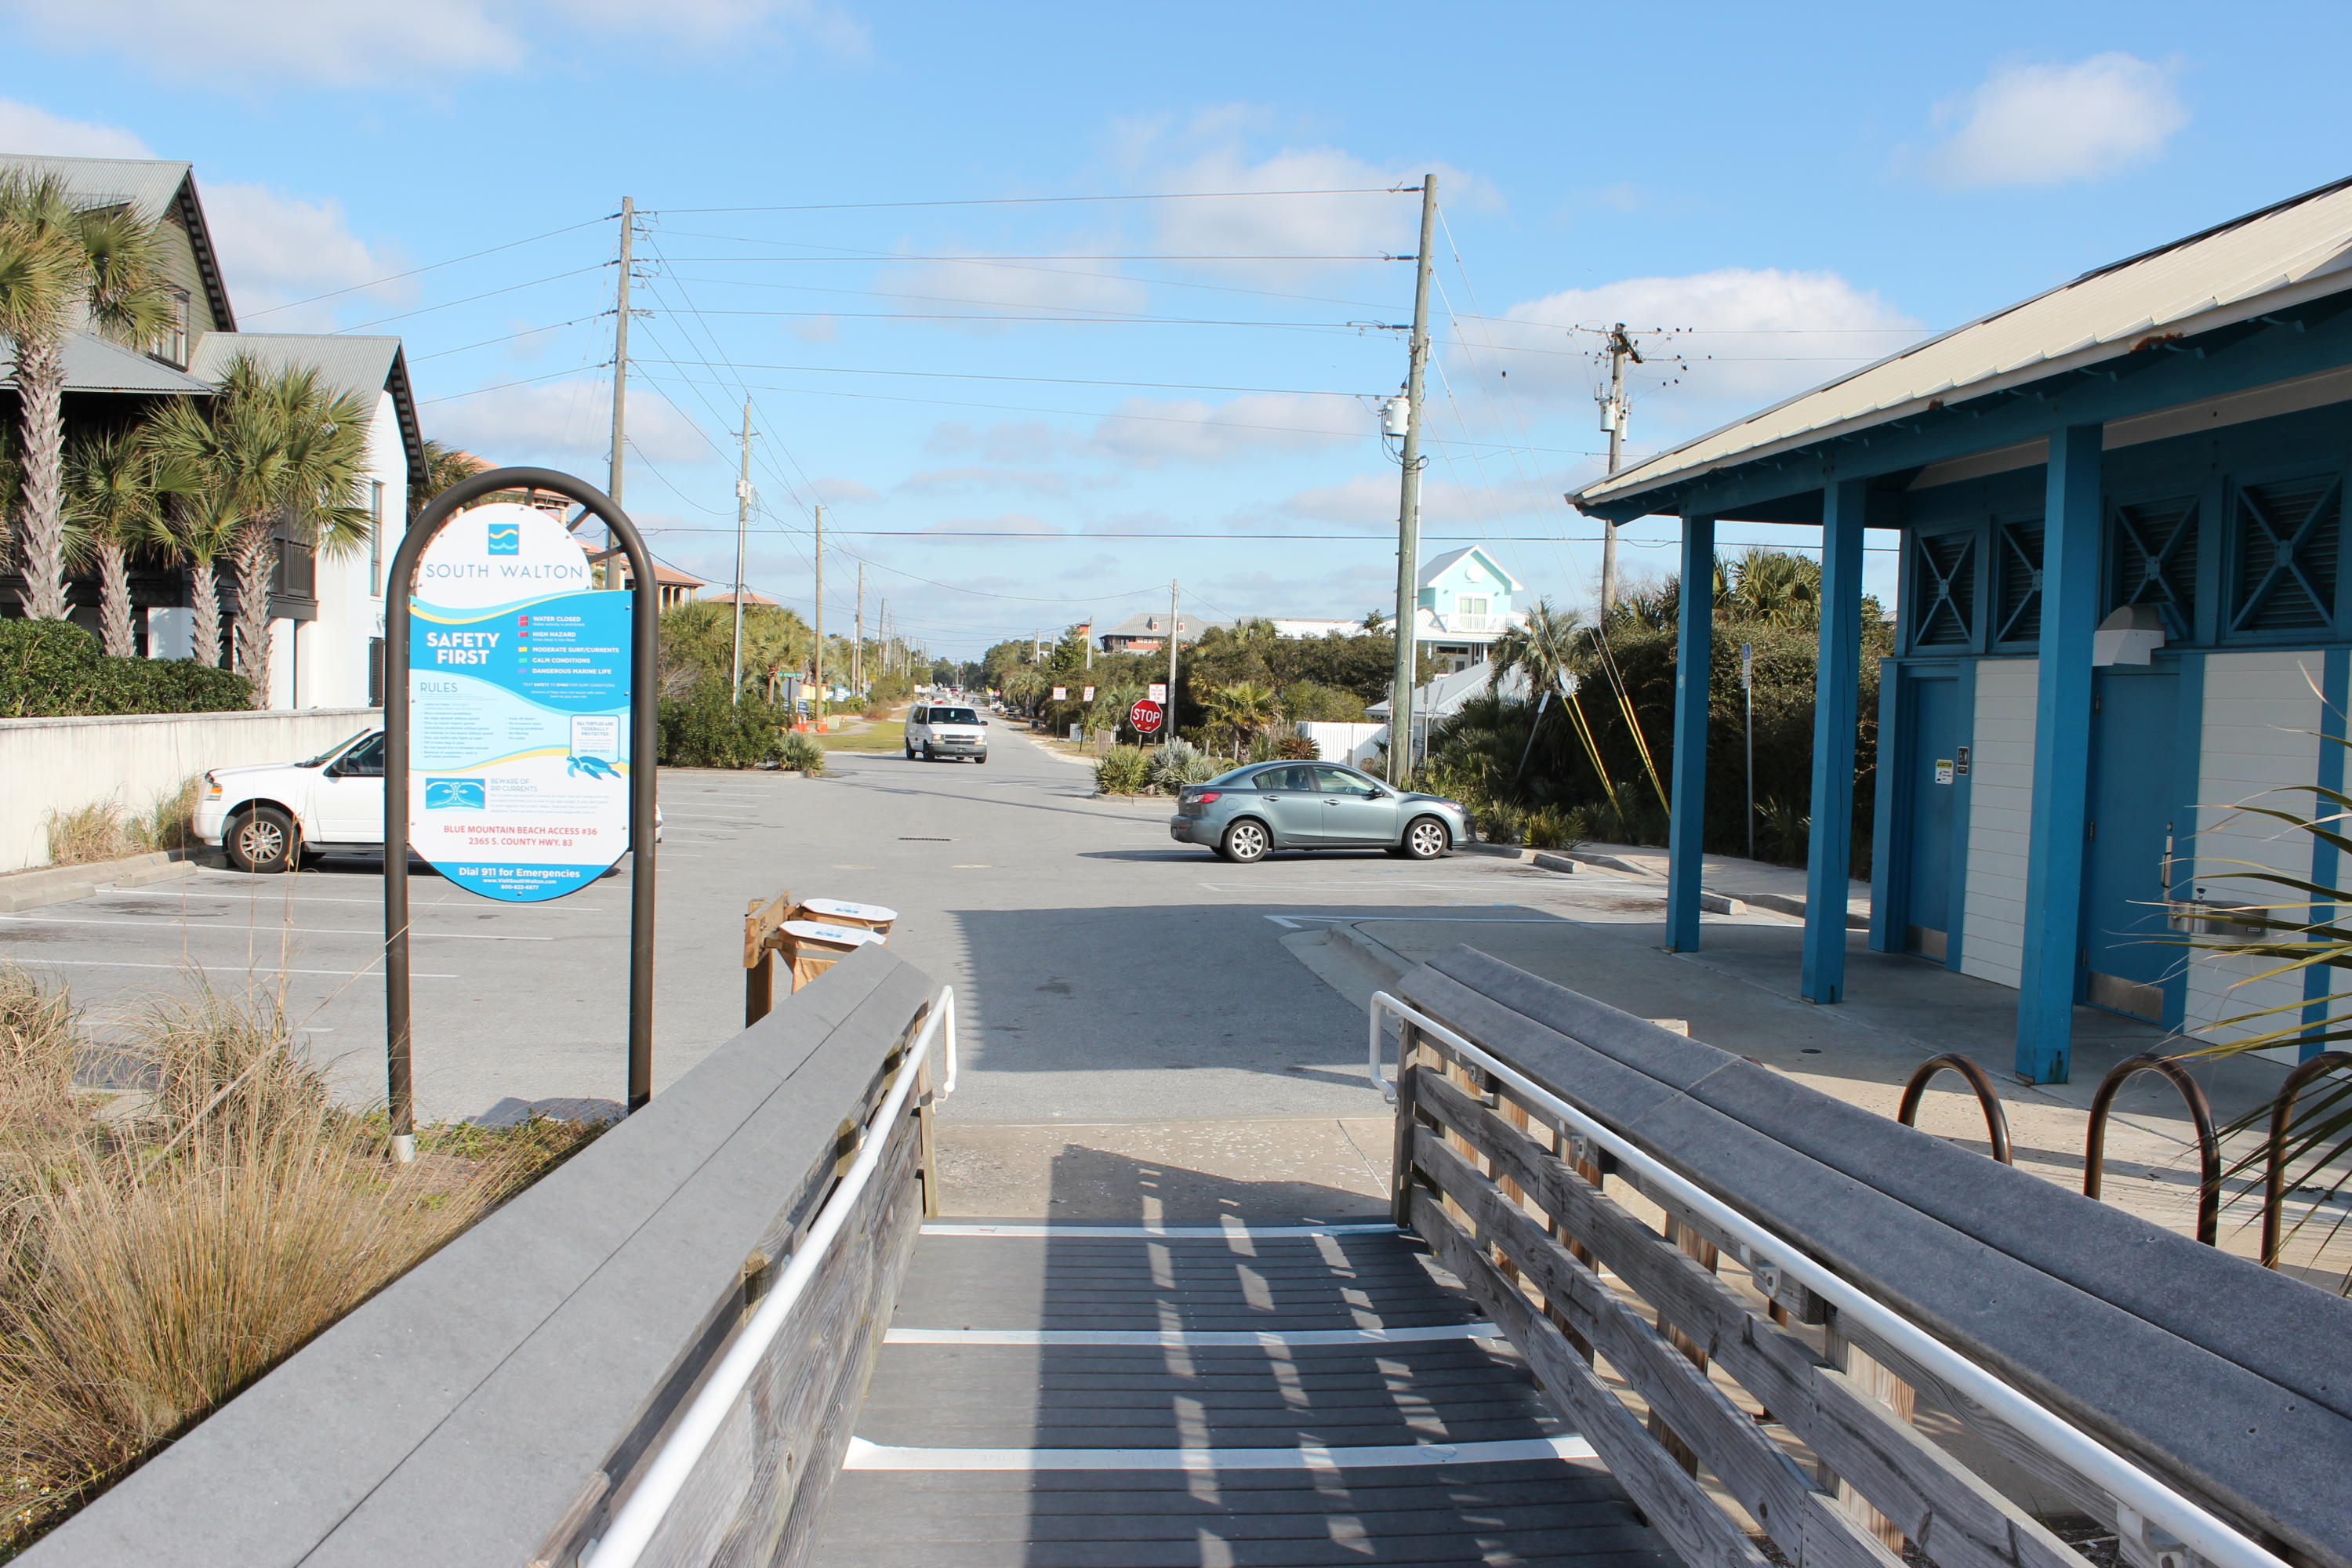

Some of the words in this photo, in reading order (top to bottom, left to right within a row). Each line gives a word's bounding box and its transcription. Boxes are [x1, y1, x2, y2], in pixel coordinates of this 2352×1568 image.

[426, 564, 489, 579] SOUTH
[500, 564, 583, 579] WALTON
[426, 632, 500, 648] SAFETY
[437, 649, 490, 665] FIRST
[420, 682, 458, 692] RULES
[1133, 708, 1160, 724] STOP
[459, 867, 478, 877] Dial
[481, 867, 496, 877] 911
[499, 868, 514, 877] for
[516, 869, 581, 879] Emergencies
